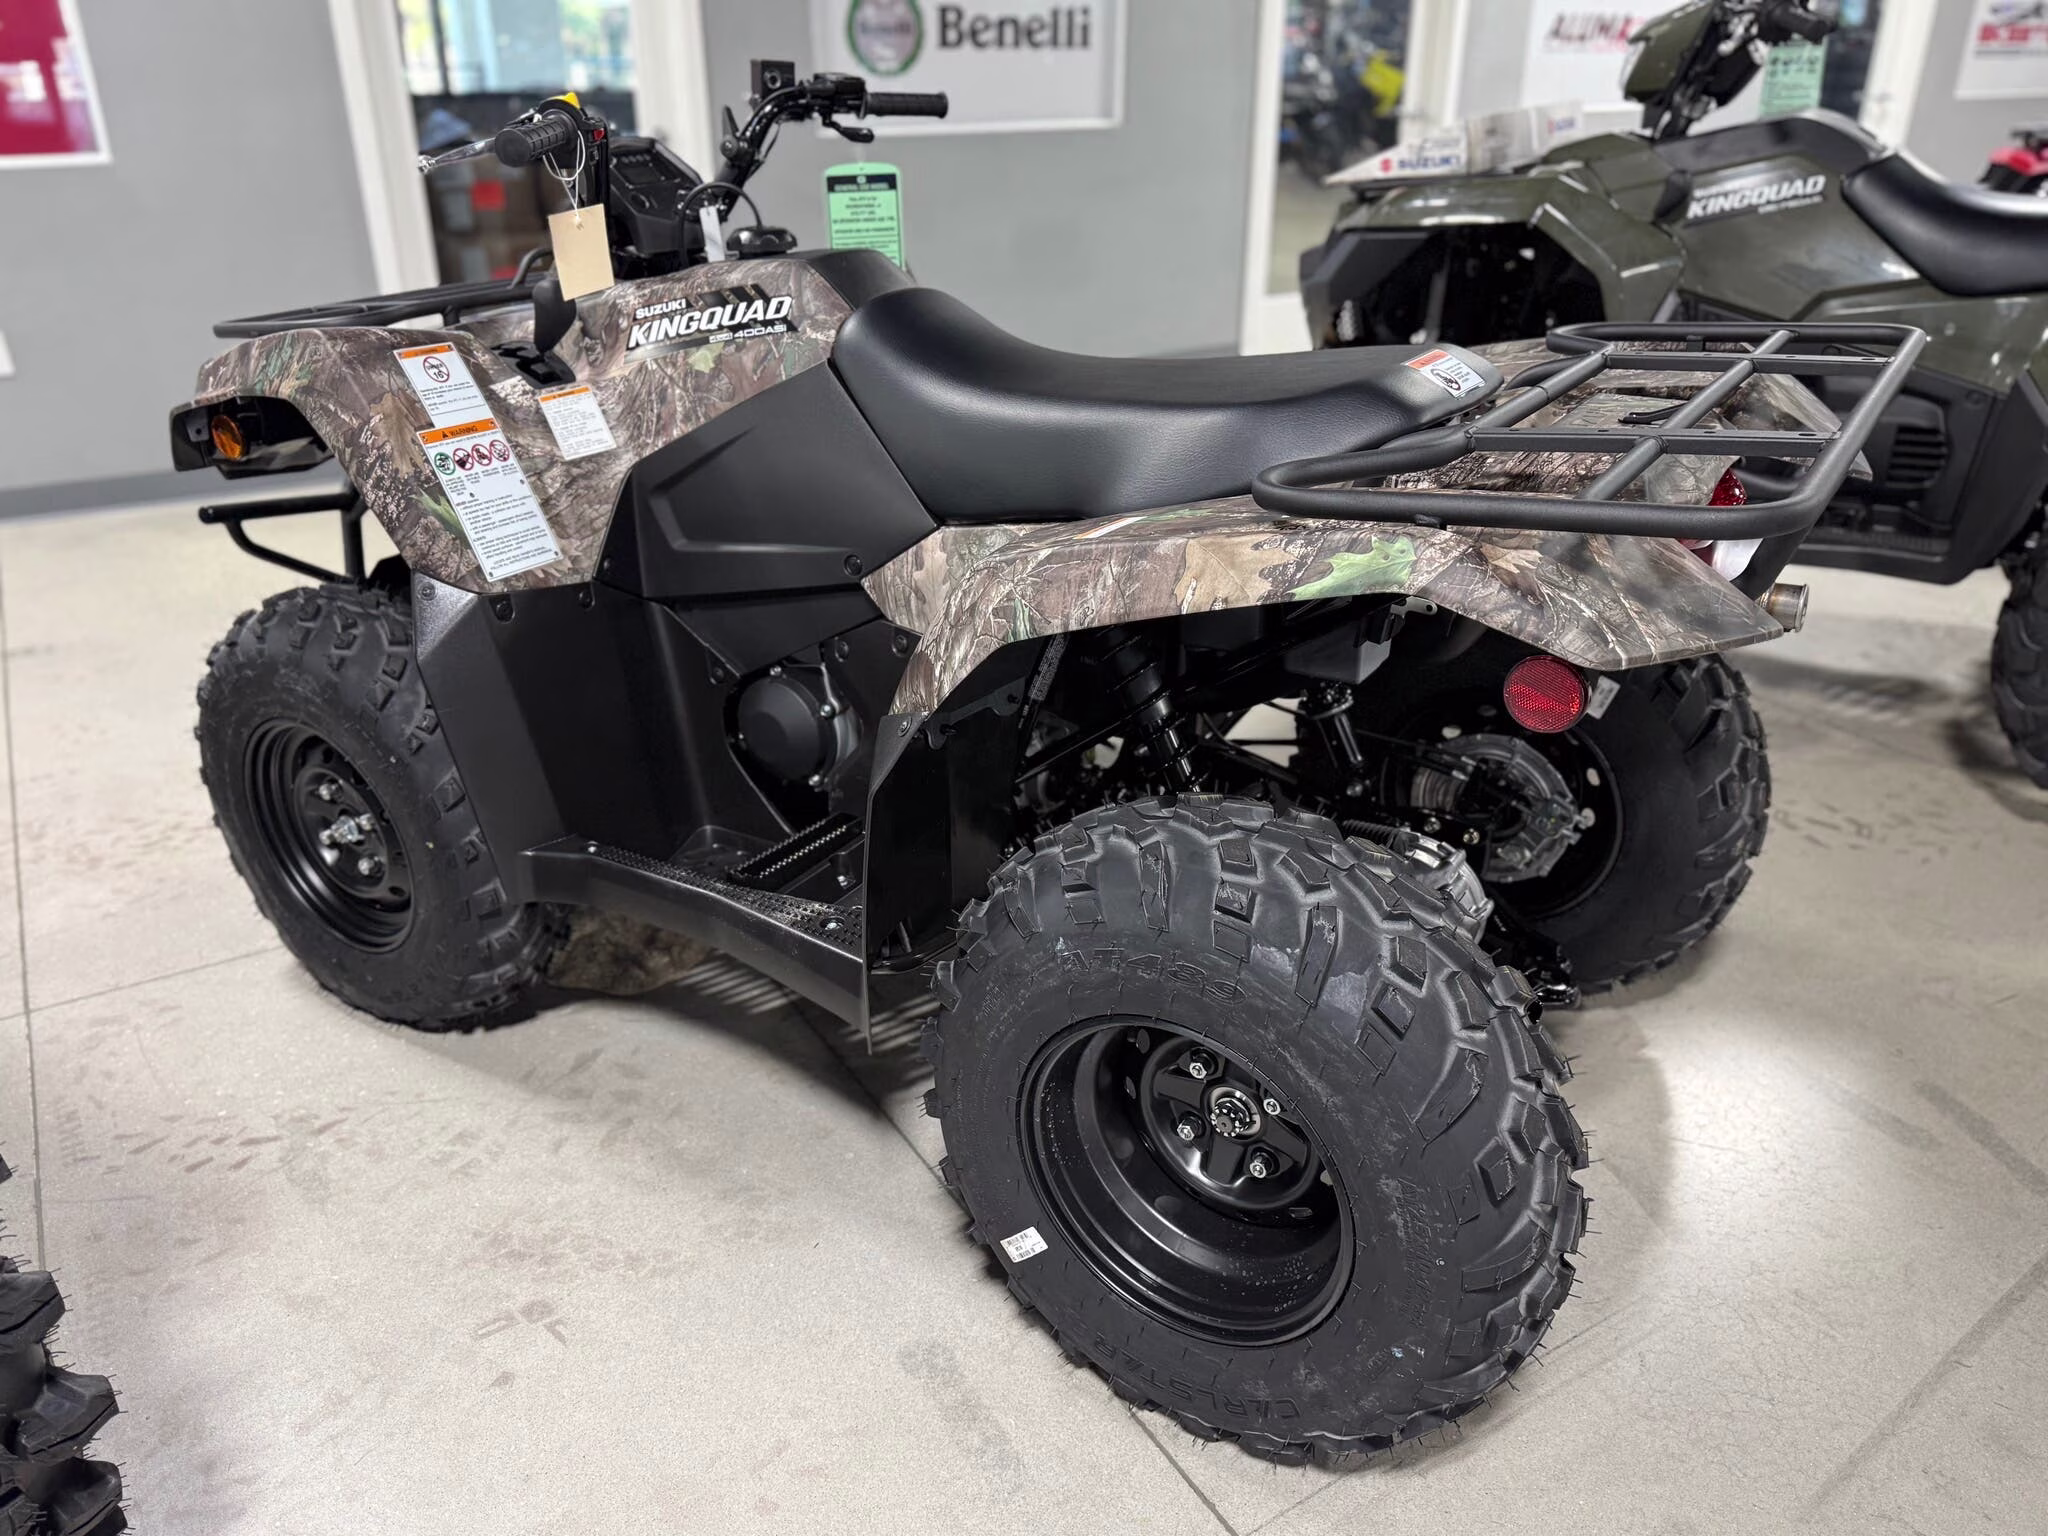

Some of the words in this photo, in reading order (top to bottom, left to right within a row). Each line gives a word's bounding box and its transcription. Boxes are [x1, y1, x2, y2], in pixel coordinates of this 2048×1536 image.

[938, 5, 1090, 48] Benelli
[1686, 174, 1826, 219] KINGQUAD
[627, 295, 792, 348] KINGQUAD
[635, 299, 686, 319] SUZUKI
[433, 370, 444, 380] 16
[450, 425, 478, 436] WARNING
